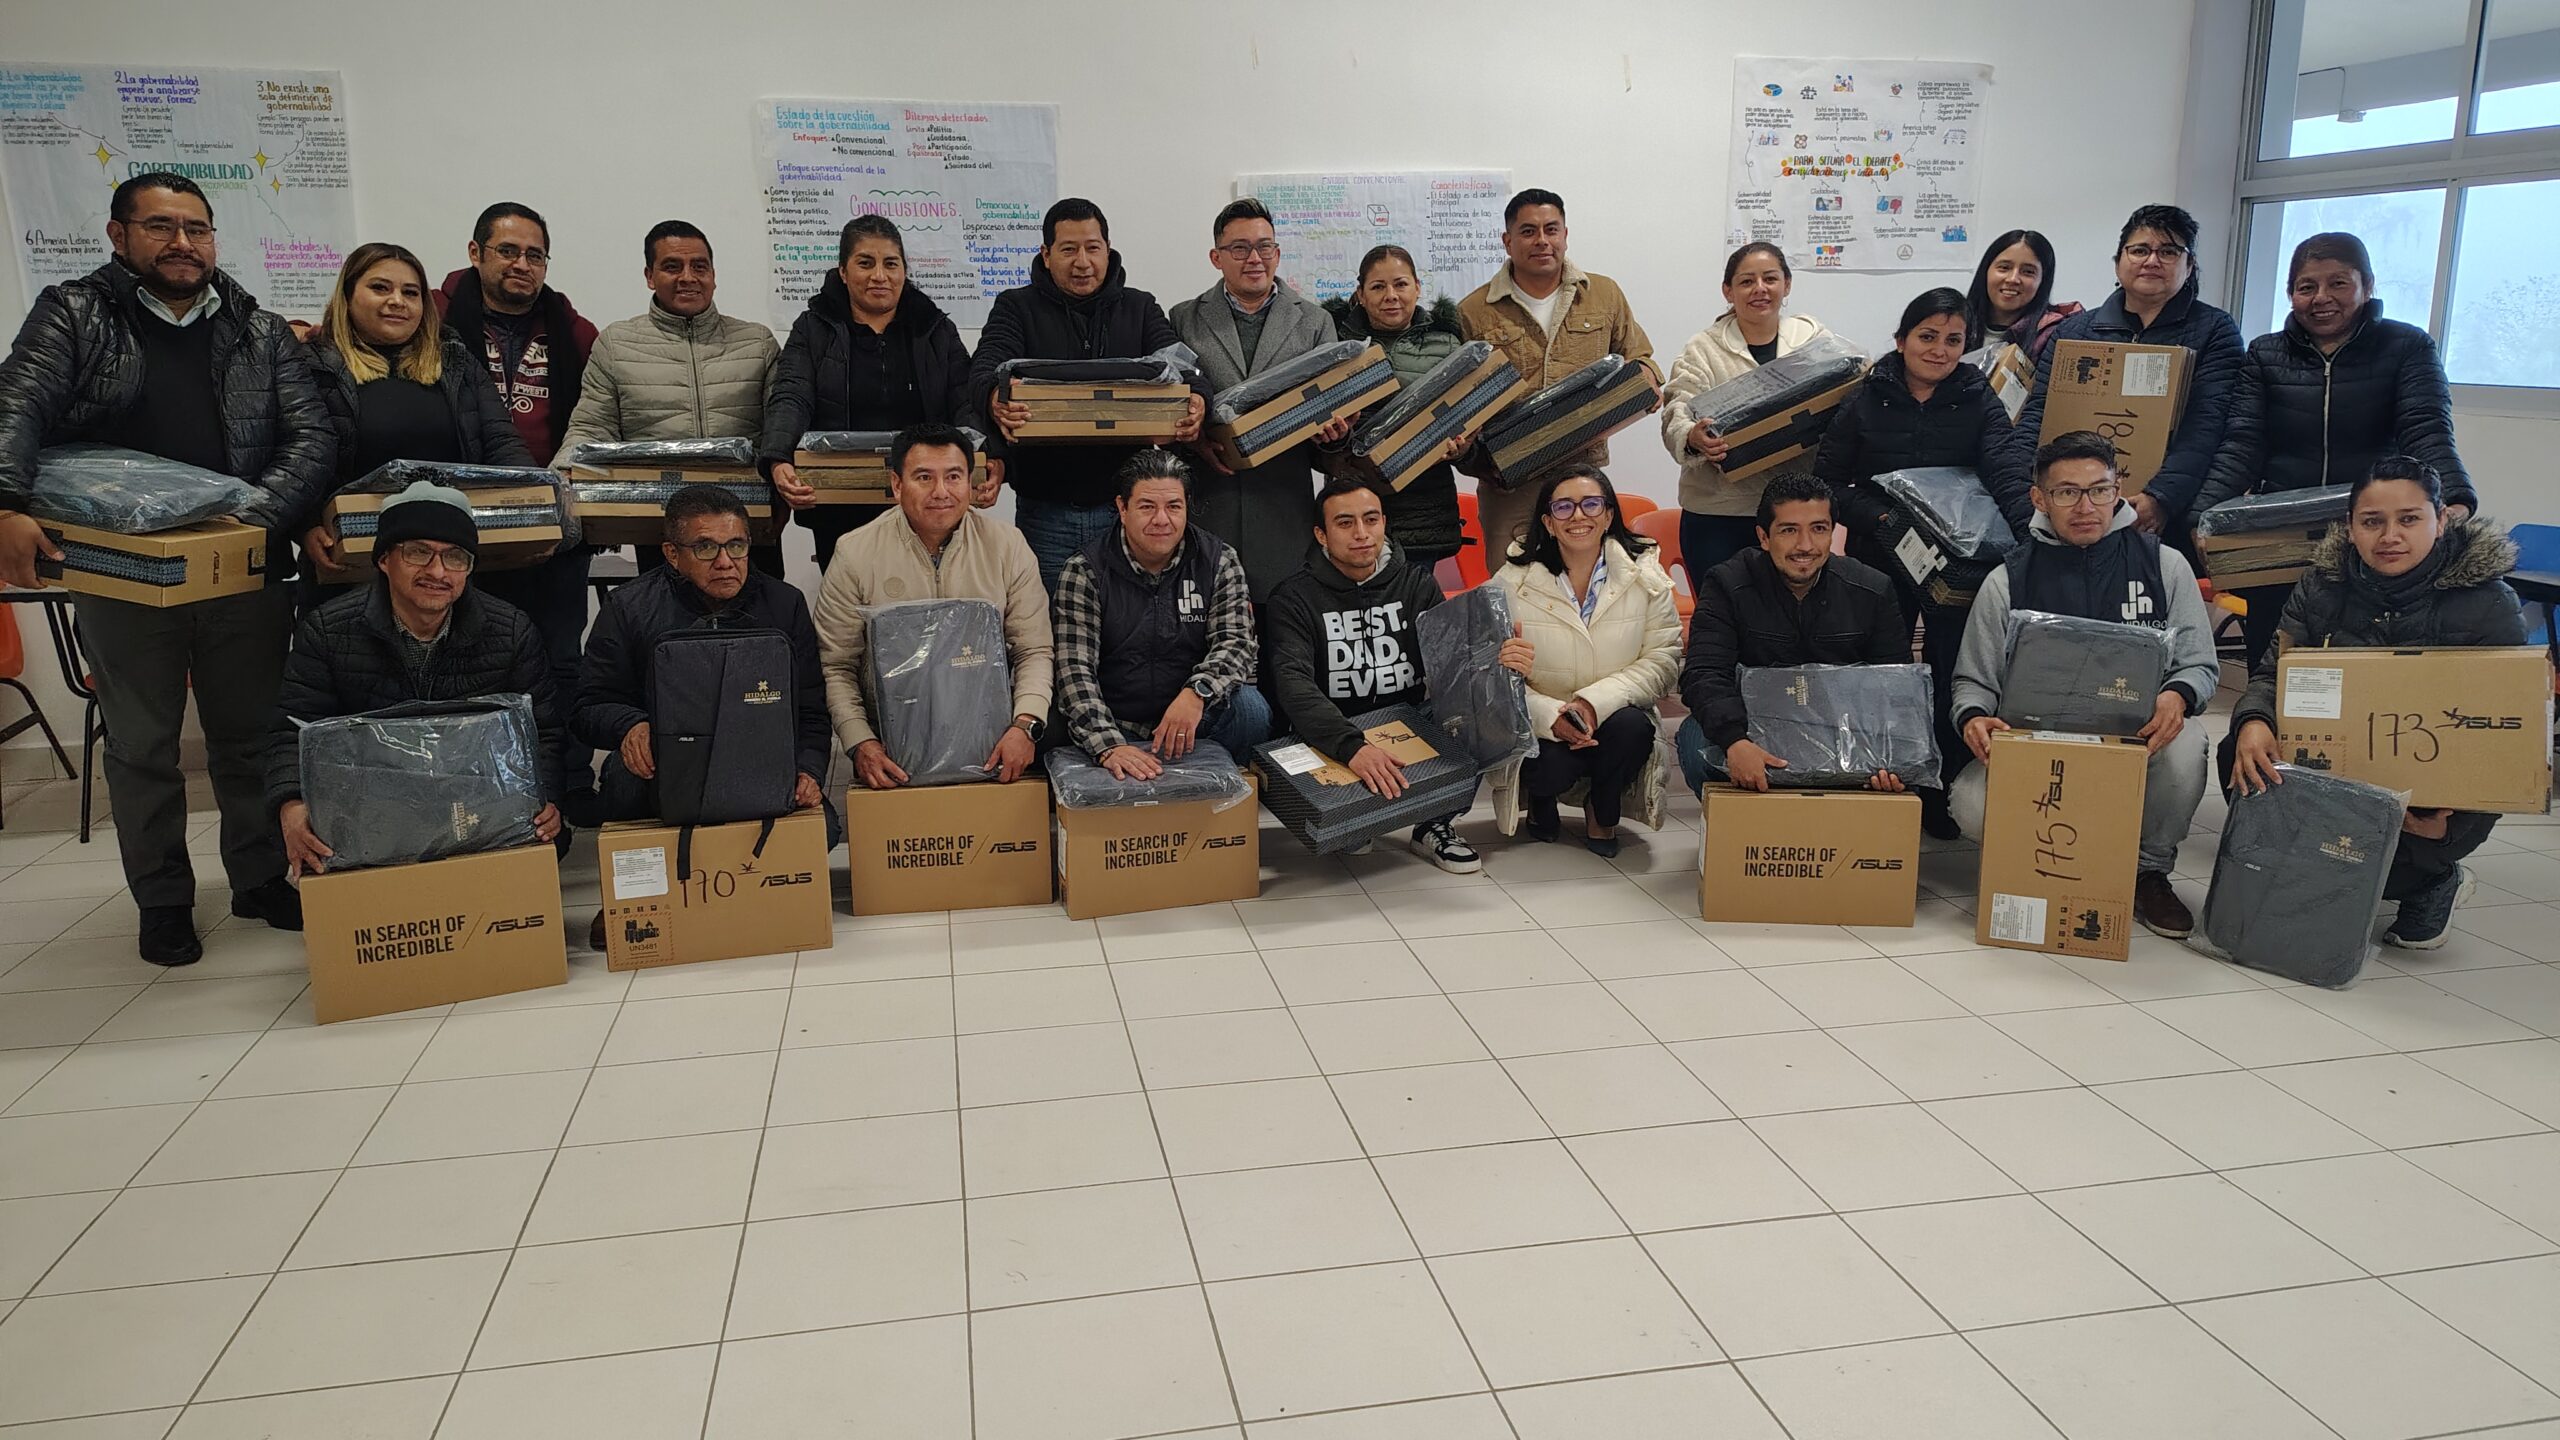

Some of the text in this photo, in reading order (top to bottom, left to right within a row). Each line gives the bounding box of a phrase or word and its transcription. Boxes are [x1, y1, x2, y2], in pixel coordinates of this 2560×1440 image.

[267, 81, 280, 92] No
[283, 80, 309, 93] existe
[267, 102, 332, 113] gobernabilidad
[776, 106, 875, 122] Estado de la cuestión
[904, 109, 939, 121] Dilemas
[778, 121, 890, 133] sobre la gobernabilidad
[838, 146, 848, 155] No
[1794, 155, 1813, 166] PARA
[1852, 156, 1862, 166] EL
[777, 160, 886, 176] Enfoque convencional de la
[769, 186, 789, 196] Como
[791, 188, 820, 199] ejercicio
[1439, 190, 1460, 200] Estado
[1480, 191, 1497, 199] actor
[1431, 199, 1459, 209] principal
[982, 210, 1040, 221] gobernabilidad
[1472, 210, 1480, 218] de
[1481, 209, 1492, 218] las
[772, 217, 797, 225] Partidos
[962, 219, 1015, 233] Los procesos de
[1466, 231, 1474, 239] de
[1475, 230, 1487, 239] las
[773, 244, 809, 256] Enfoque
[968, 241, 990, 255] Mayor
[1468, 242, 1477, 251] de
[780, 267, 799, 275] Busca
[1015, 266, 1026, 276] de
[981, 277, 995, 285] dad
[1008, 277, 1016, 285] la
[212, 551, 220, 584] ASUS
[1180, 614, 1207, 623] HIDAL
[1322, 601, 1407, 640] BEST.
[1328, 636, 1407, 671] DAD.
[1328, 661, 1421, 698] EVER.
[2098, 686, 2140, 697] HIDALGO
[2454, 715, 2522, 730] ASUS
[2367, 711, 2439, 763] 173
[2047, 759, 2064, 811] ASUS
[457, 802, 468, 840] HIDALGO
[887, 834, 975, 853] IN SEARCH OF
[988, 841, 1037, 854] ASUS
[1104, 832, 1188, 854] IN SEARCH OF
[1201, 835, 1246, 849] ASUS
[1745, 846, 1837, 861] IN SEARCH OF
[2034, 822, 2081, 880] 175
[2321, 842, 2365, 858] HIDALGO
[887, 852, 964, 869] INCREDIBLE
[1105, 849, 1178, 870] INCREDIBLE
[1851, 858, 1903, 870] ASUS
[1744, 862, 1824, 878] INCREDIBLE
[759, 872, 813, 888] ASUS
[679, 869, 735, 908] 170
[355, 914, 467, 945] IN SEARCH OF
[486, 915, 545, 935] ASUS
[357, 935, 455, 964] INCREDIBLE
